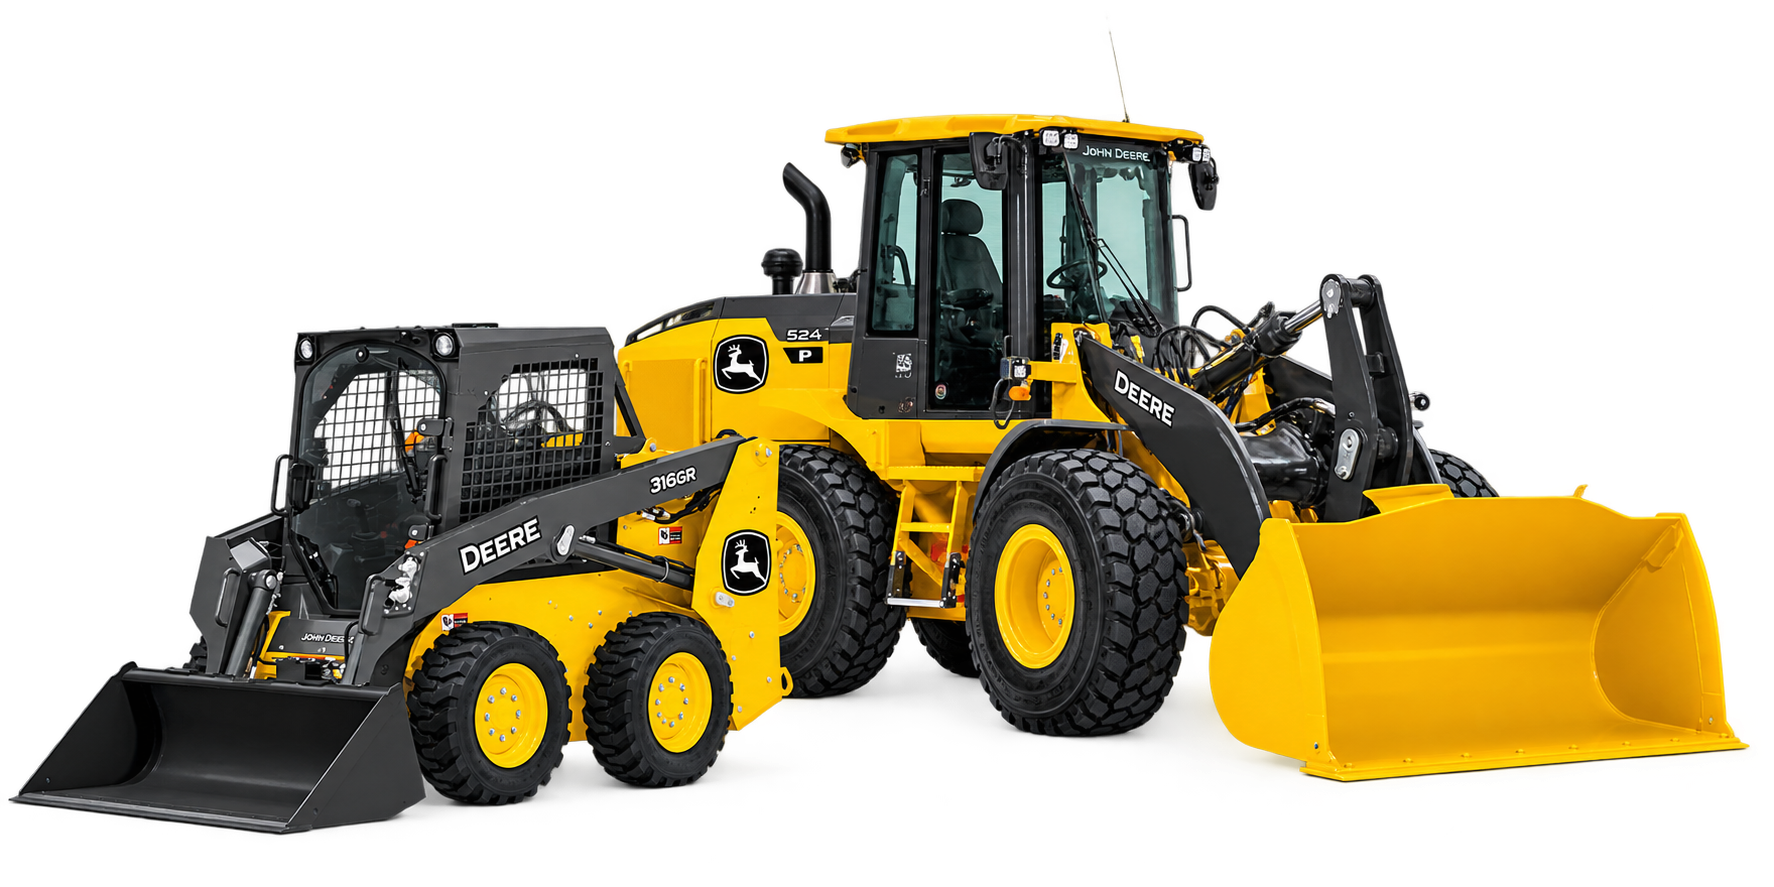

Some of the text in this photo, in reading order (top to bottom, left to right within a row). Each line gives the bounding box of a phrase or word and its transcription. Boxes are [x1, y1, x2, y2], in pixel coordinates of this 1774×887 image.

[1082, 145, 1151, 162] JOHN DEERE
[786, 329, 822, 341] 524
[798, 349, 812, 362] P
[1114, 370, 1175, 427] DEERE
[650, 467, 697, 494] 316GR
[459, 518, 541, 573] DEERE
[301, 633, 325, 642] JOHN
